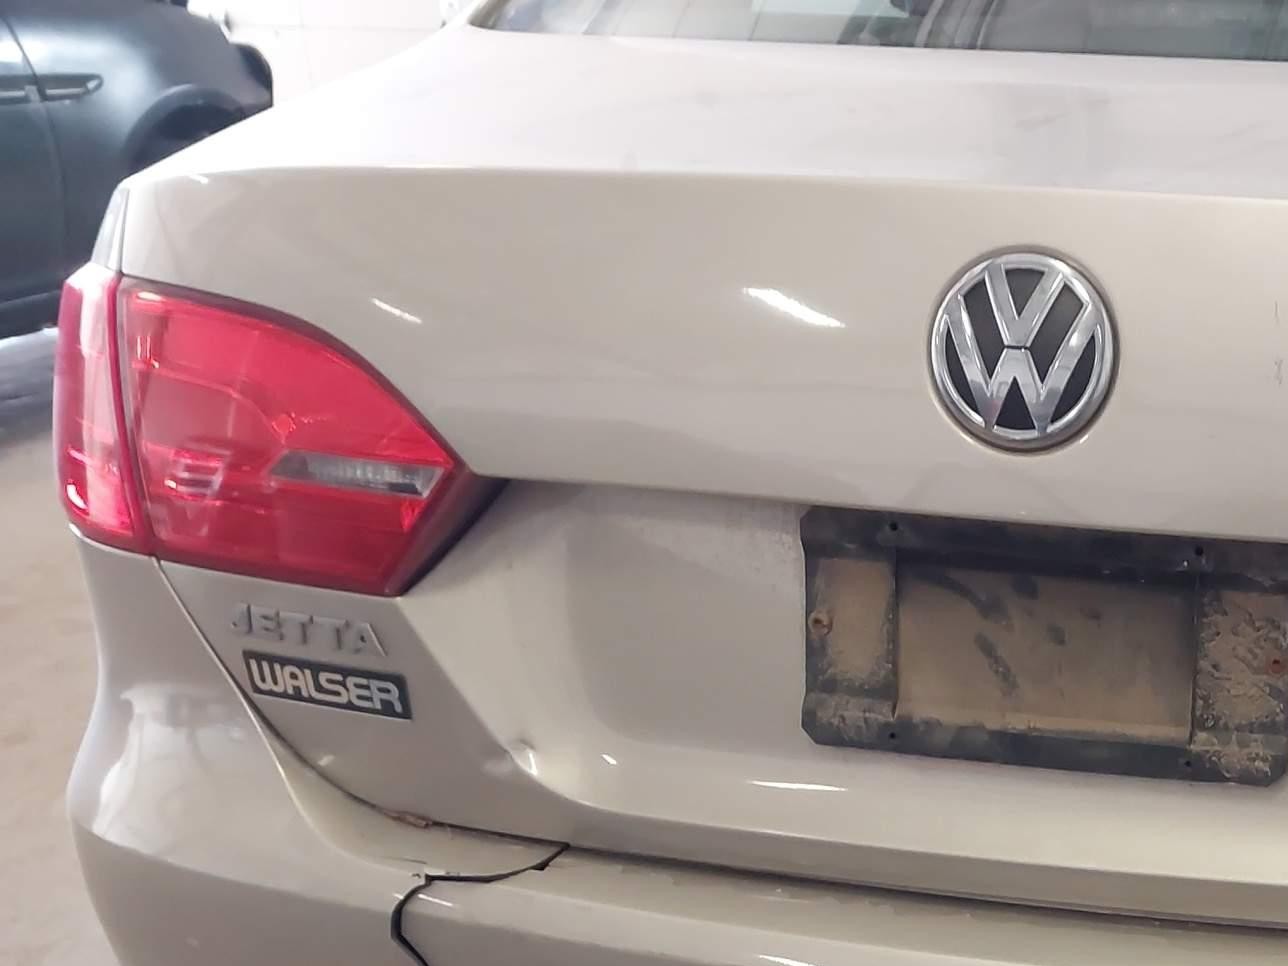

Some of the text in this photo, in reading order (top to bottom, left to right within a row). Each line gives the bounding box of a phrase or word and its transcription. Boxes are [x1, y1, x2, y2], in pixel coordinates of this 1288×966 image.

[938, 257, 1104, 438] VW
[231, 603, 387, 657] JETTA
[249, 658, 403, 713] WALSER
